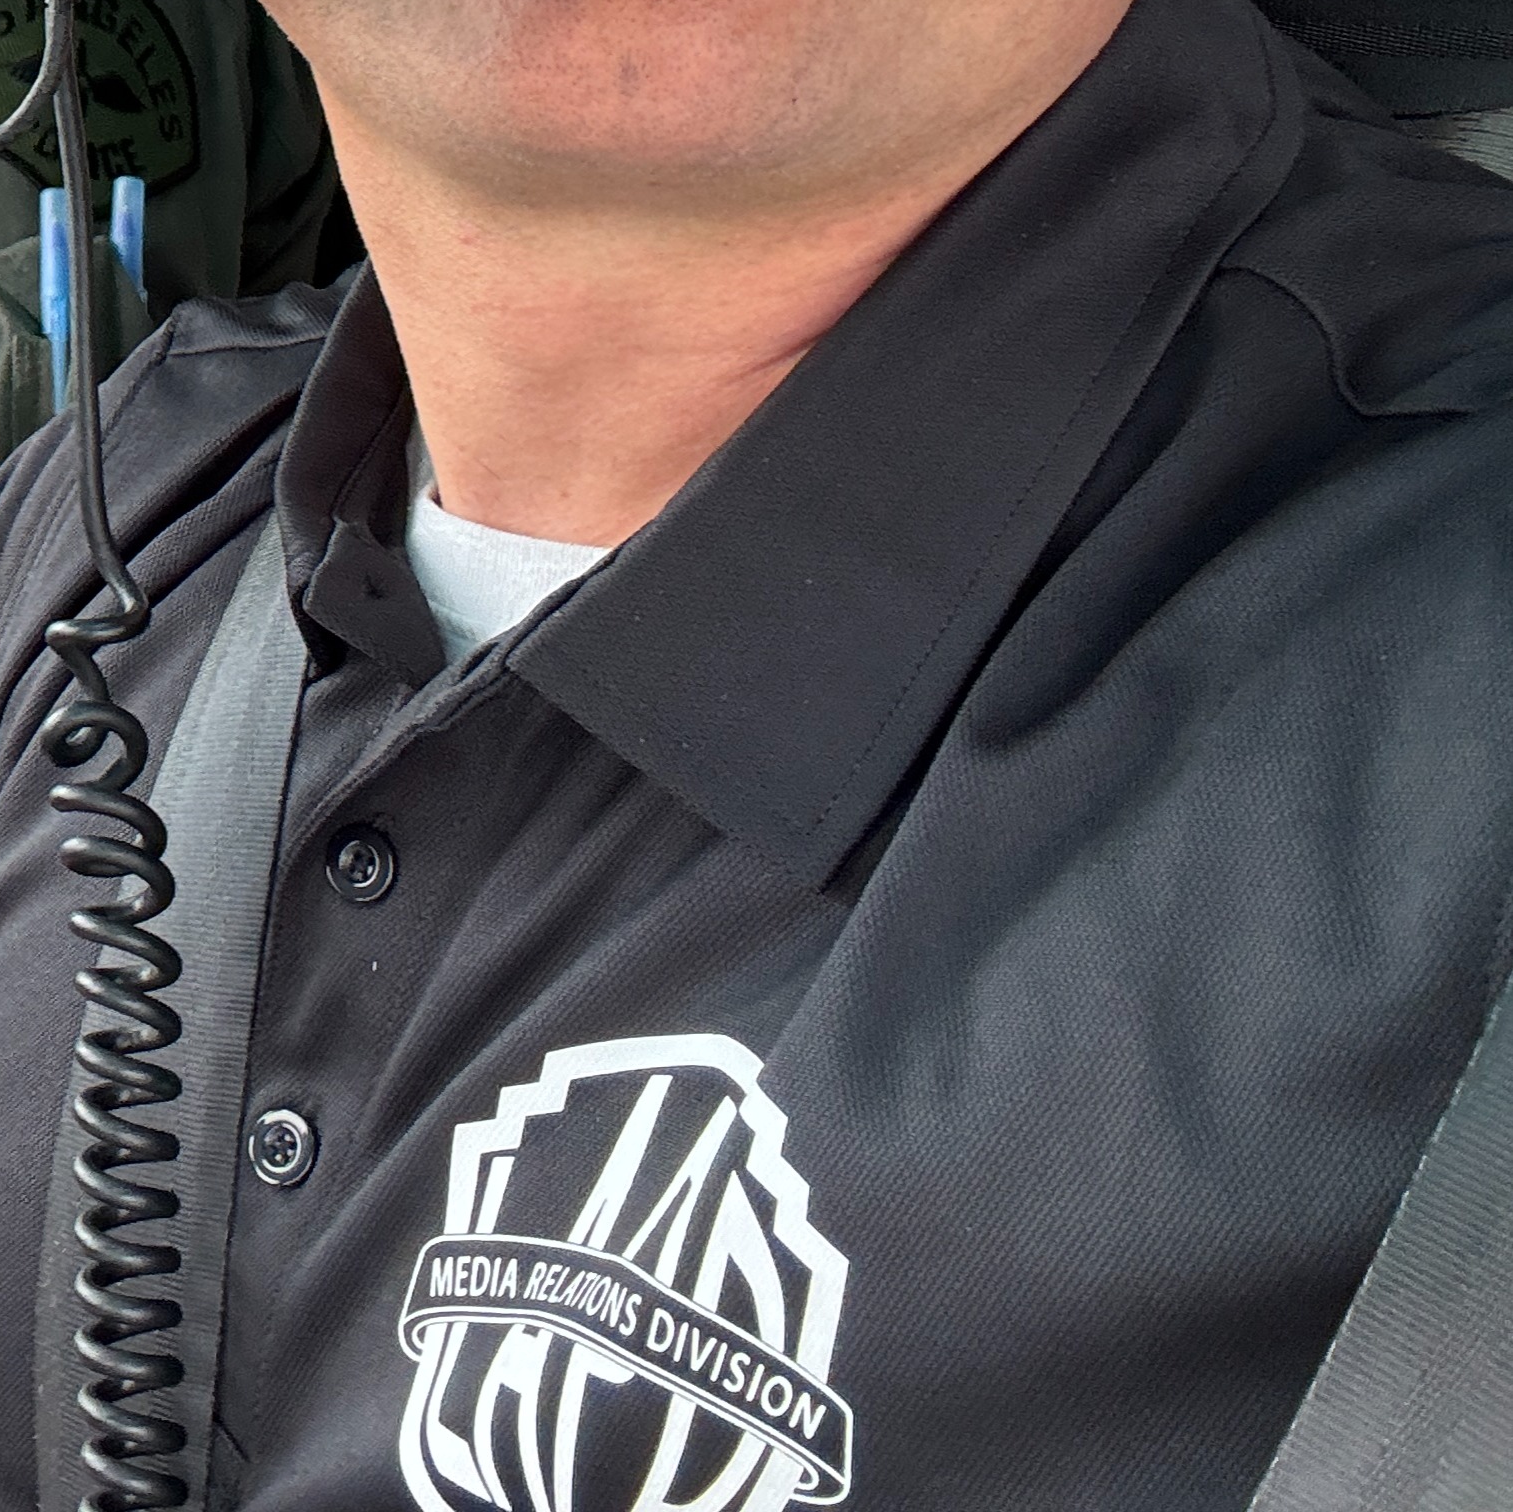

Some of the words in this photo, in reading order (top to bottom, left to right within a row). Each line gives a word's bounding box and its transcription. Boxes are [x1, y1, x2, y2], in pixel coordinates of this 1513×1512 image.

[429, 1255, 518, 1300] MEDIA
[522, 1261, 643, 1337] RELATIONS
[646, 1307, 828, 1440] DIVISION
